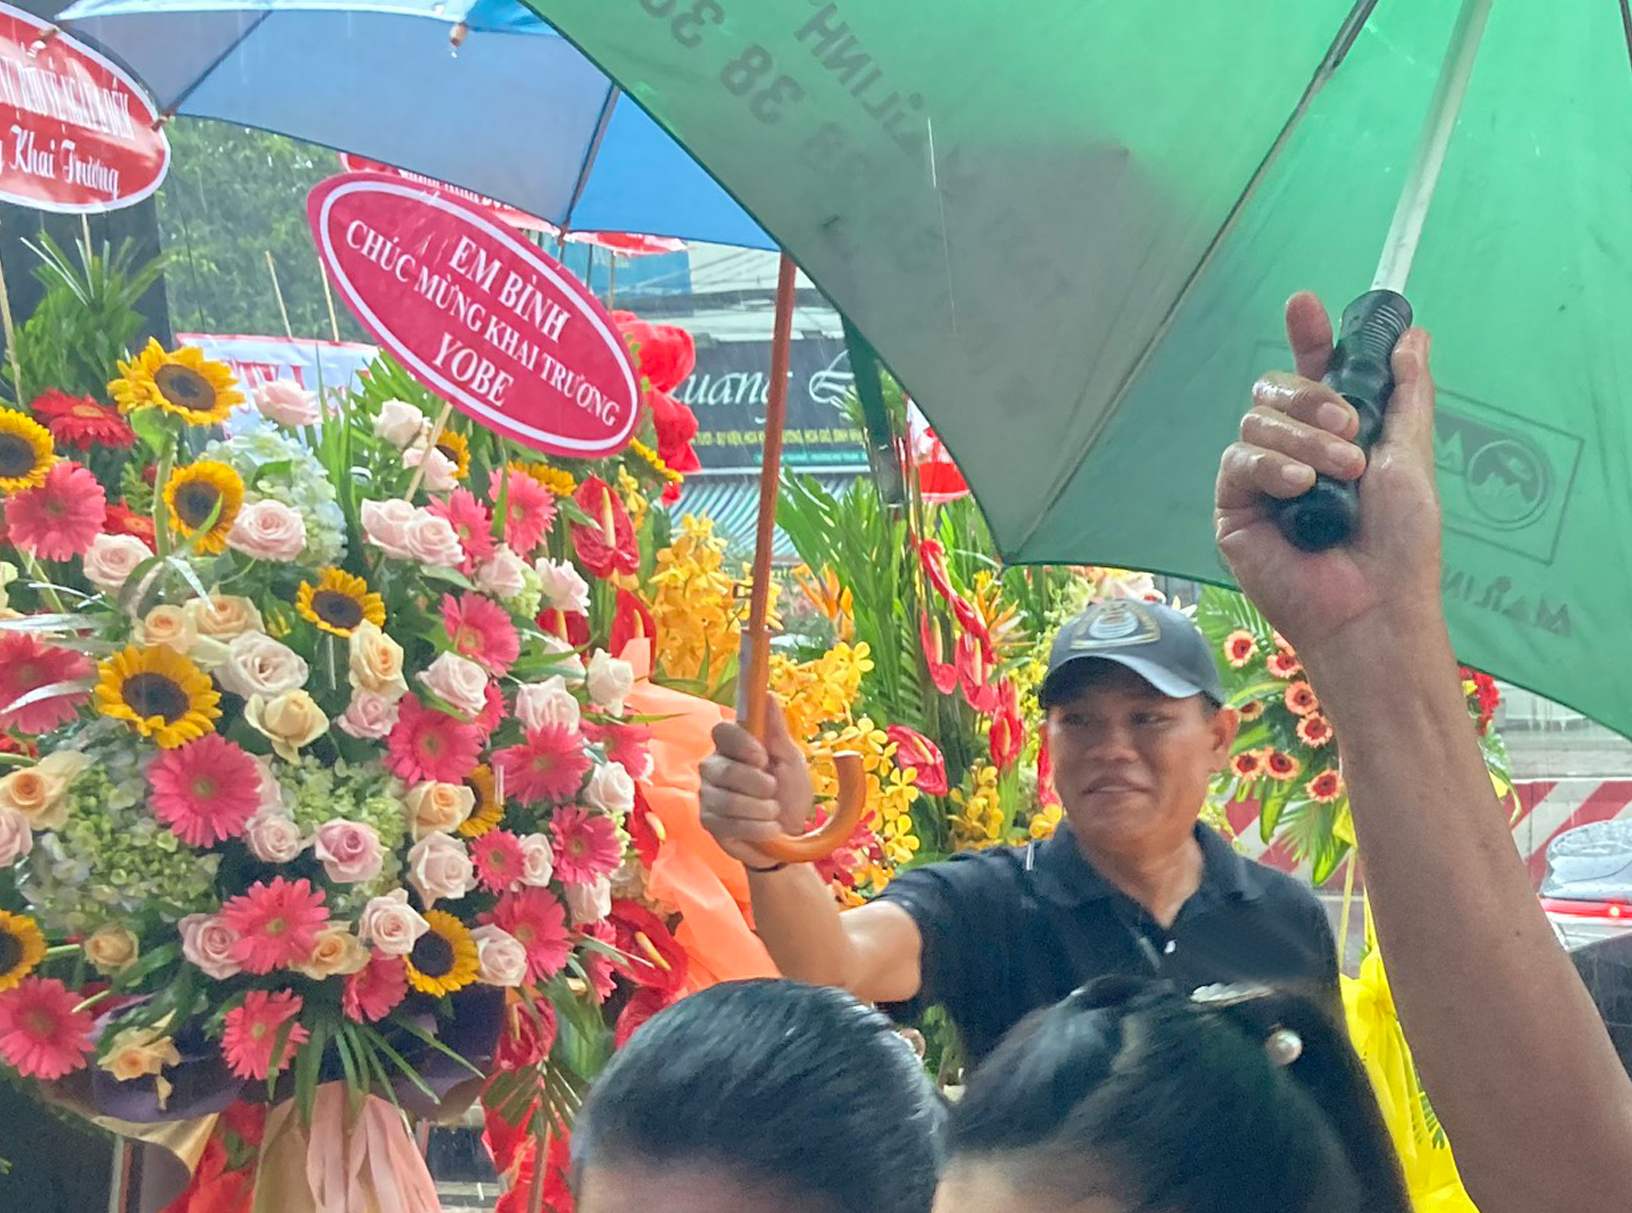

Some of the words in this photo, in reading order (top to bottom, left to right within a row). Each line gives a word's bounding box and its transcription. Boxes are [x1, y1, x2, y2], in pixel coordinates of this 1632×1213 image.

[8, 123, 56, 181] Khai
[346, 219, 417, 283] CHÚC
[414, 264, 486, 333] MỪNG
[484, 314, 540, 371] KHAI
[449, 235, 503, 293] EM
[498, 274, 571, 344] BÌNH
[432, 331, 514, 407] YOBE
